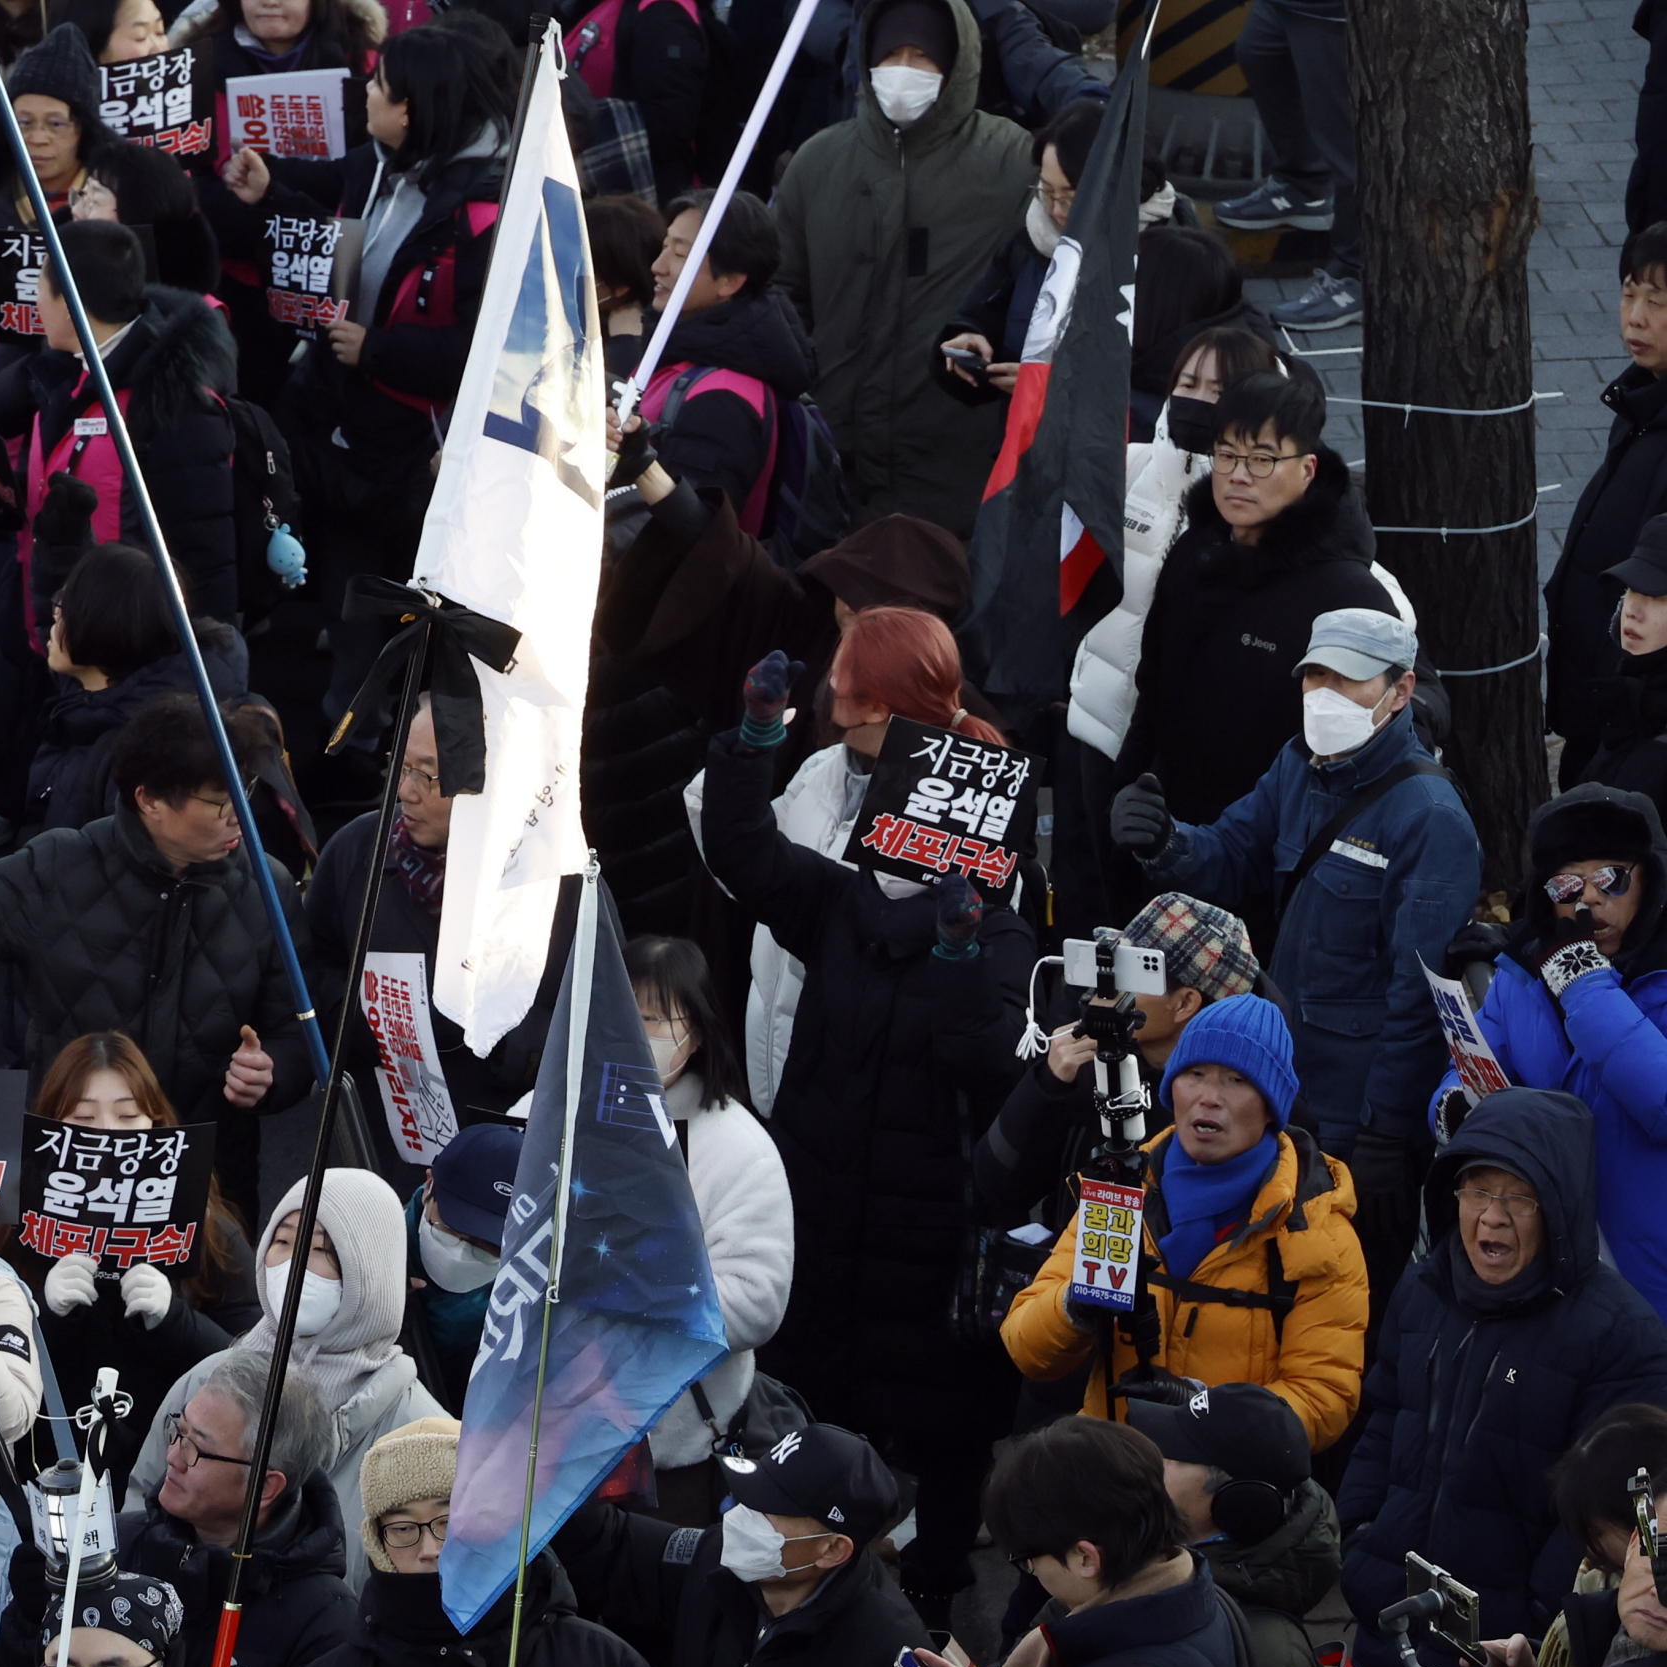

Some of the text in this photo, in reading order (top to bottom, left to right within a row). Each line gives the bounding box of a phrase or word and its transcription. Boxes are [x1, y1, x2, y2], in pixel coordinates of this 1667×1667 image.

[265, 214, 343, 254] 지금당장
[271, 253, 334, 294] 윤석열
[1250, 636, 1277, 653] Jeep
[908, 732, 1031, 797] 지금당장
[906, 777, 1016, 843] 윤석열
[860, 812, 1019, 890] 체포!구속!
[34, 1126, 190, 1177] 지금당장
[42, 1174, 180, 1224] 윤석열
[1085, 1202, 1135, 1236] 꿈과
[1097, 1190, 1121, 1203] 라이브
[1124, 1195, 1140, 1208] 방송
[18, 1210, 194, 1270] 체포!구속!
[1081, 1231, 1133, 1263] 희망
